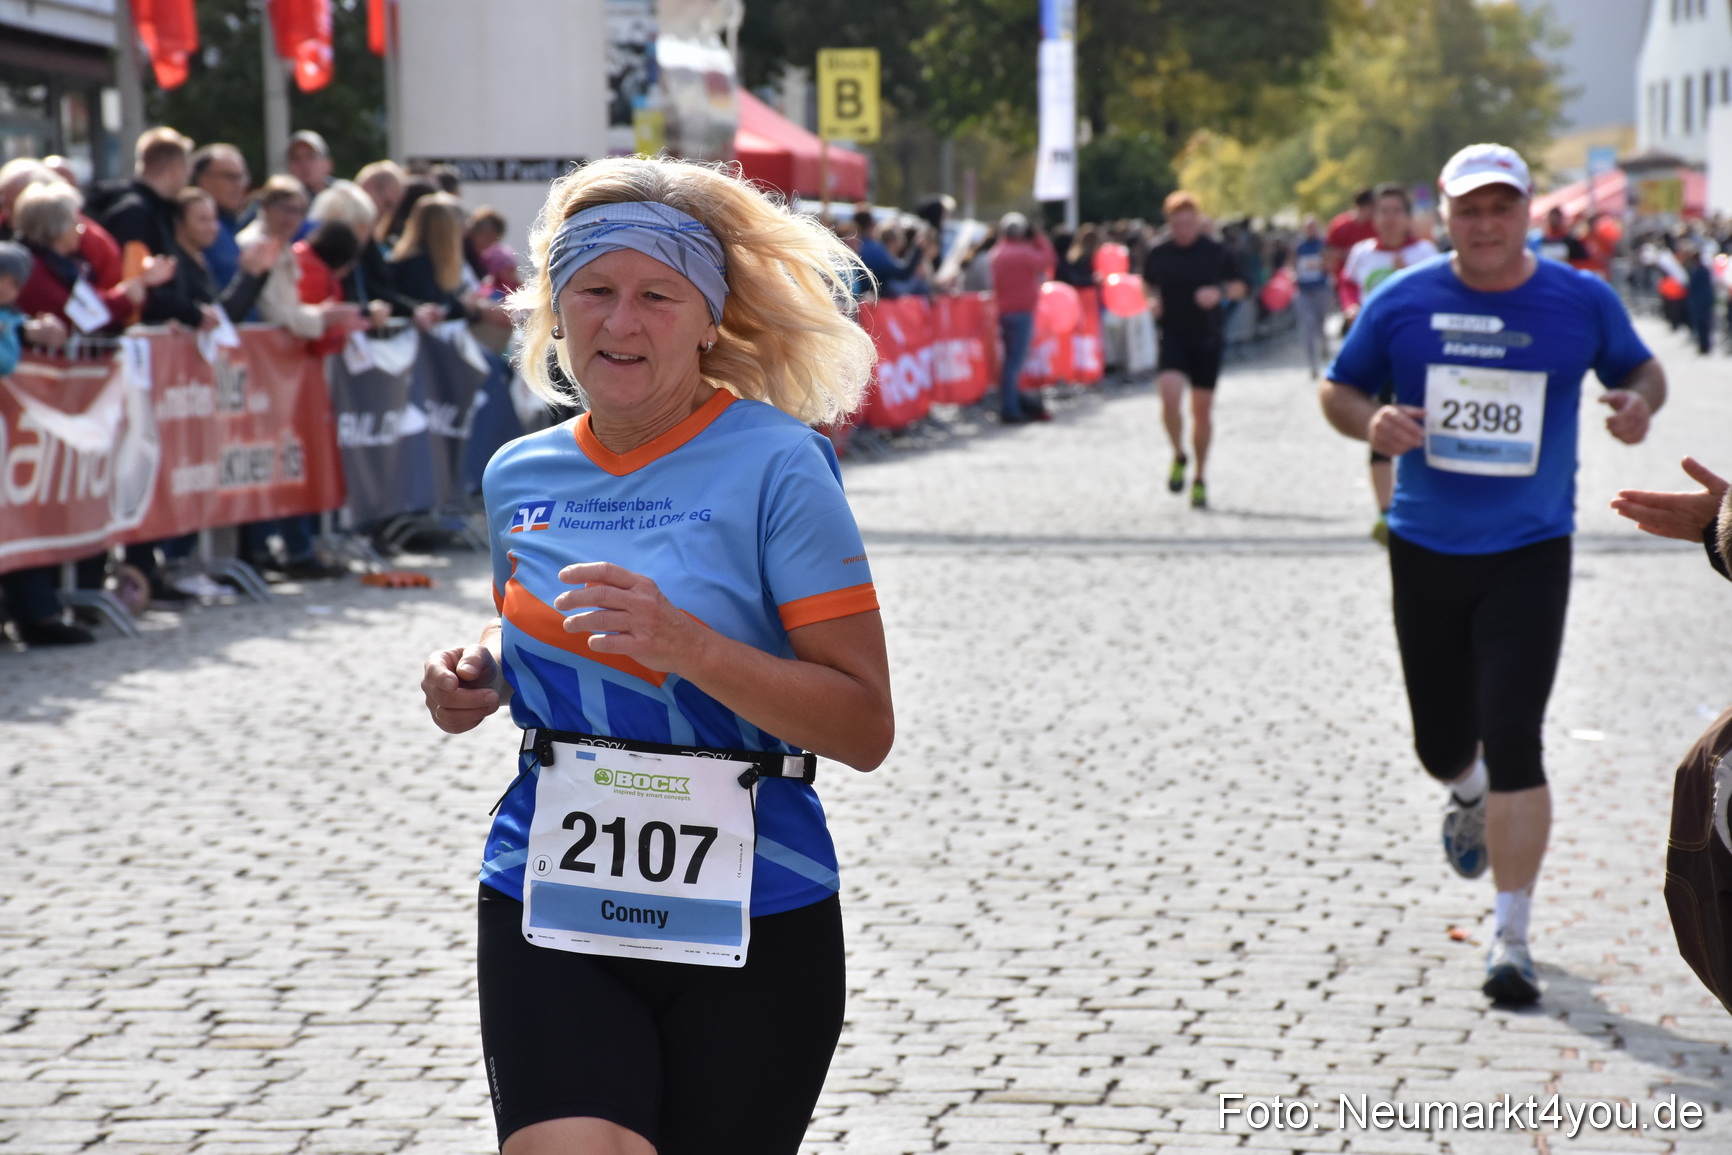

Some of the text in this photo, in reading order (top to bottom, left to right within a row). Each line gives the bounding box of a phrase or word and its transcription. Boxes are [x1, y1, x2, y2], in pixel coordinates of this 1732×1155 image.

[835, 78, 863, 119] B
[1441, 400, 1522, 434] 2398
[564, 497, 673, 513] Raiffeisenbank
[558, 516, 635, 531] Neumarkt
[689, 509, 712, 522] eG
[613, 788, 636, 797] inspired
[614, 770, 690, 794] BOCK
[559, 811, 718, 884] 2107
[538, 860, 546, 871] D
[601, 900, 669, 929] Conny
[489, 1056, 500, 1100] CRAFT
